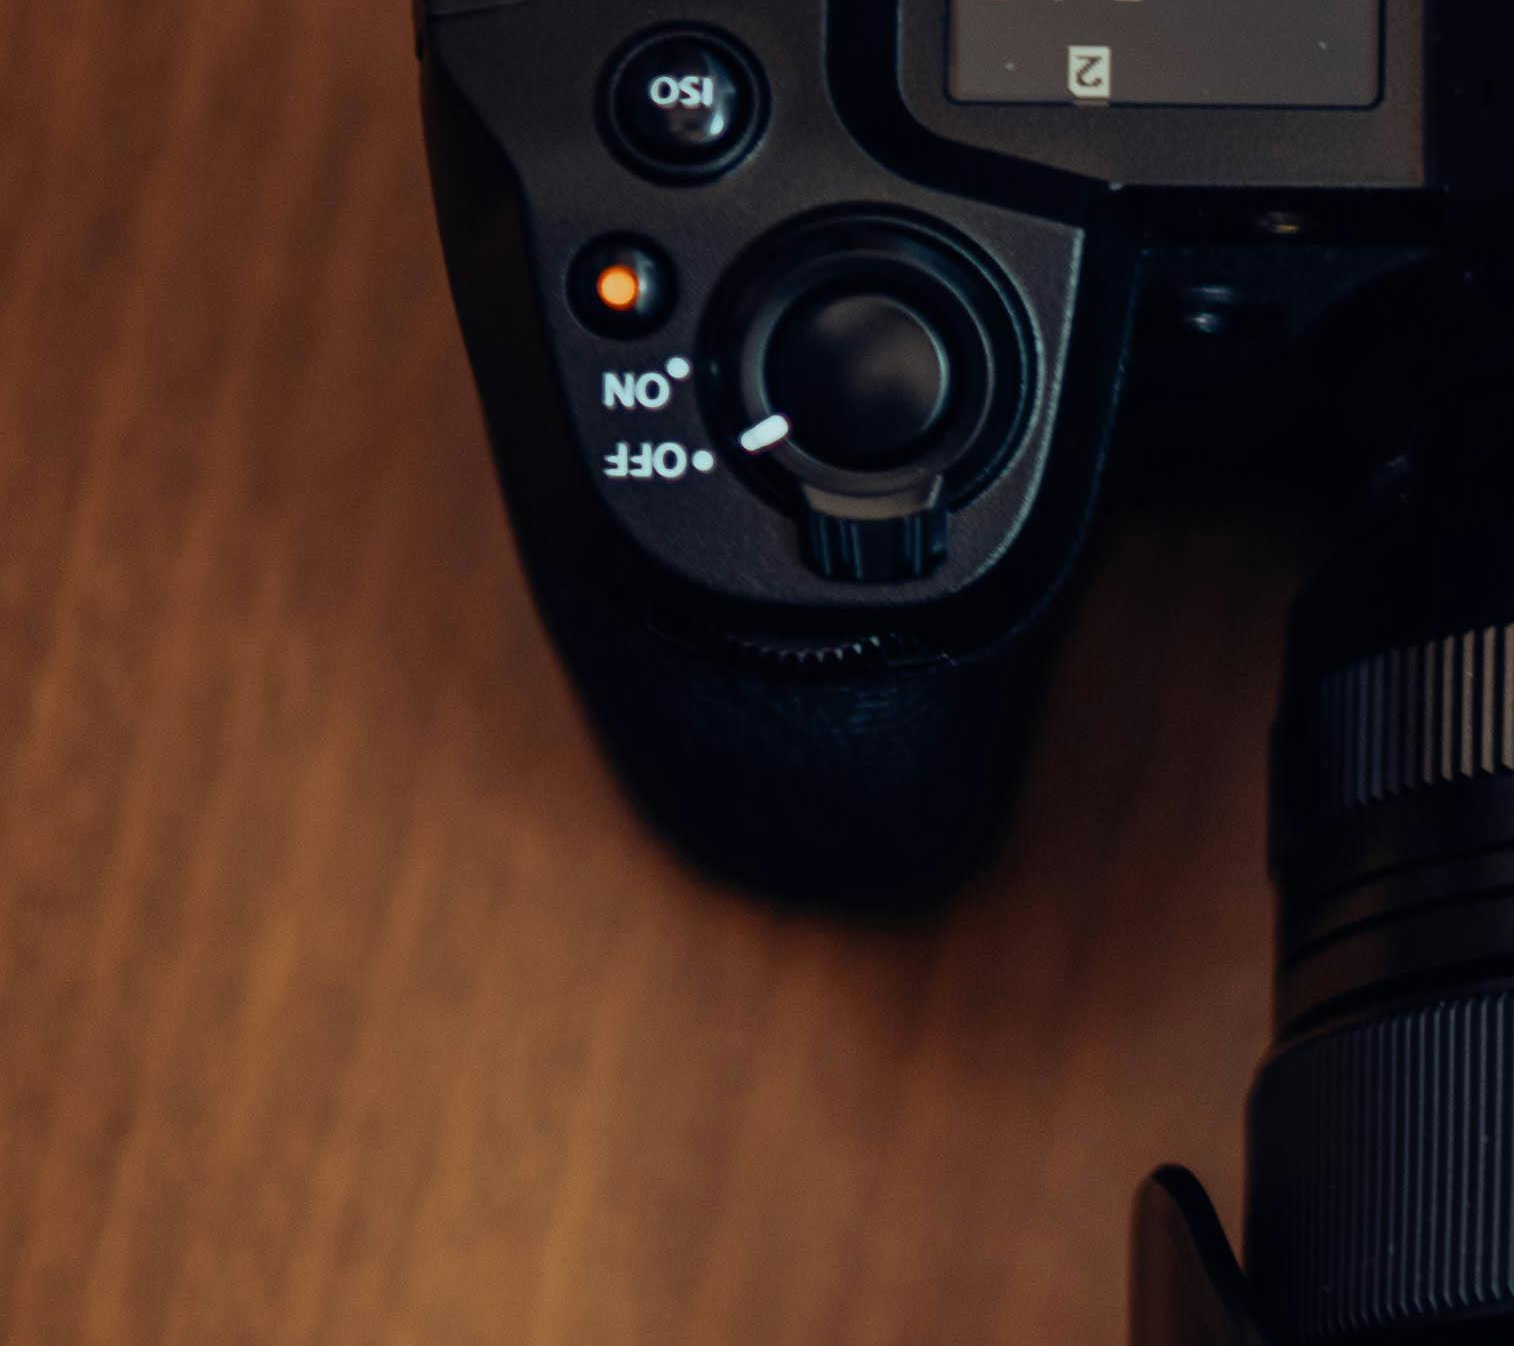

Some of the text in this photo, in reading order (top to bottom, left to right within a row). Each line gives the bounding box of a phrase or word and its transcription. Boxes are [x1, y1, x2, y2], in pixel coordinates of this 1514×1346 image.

[649, 73, 714, 108] ISO
[603, 371, 670, 409] ON
[603, 441, 687, 479] OFF
